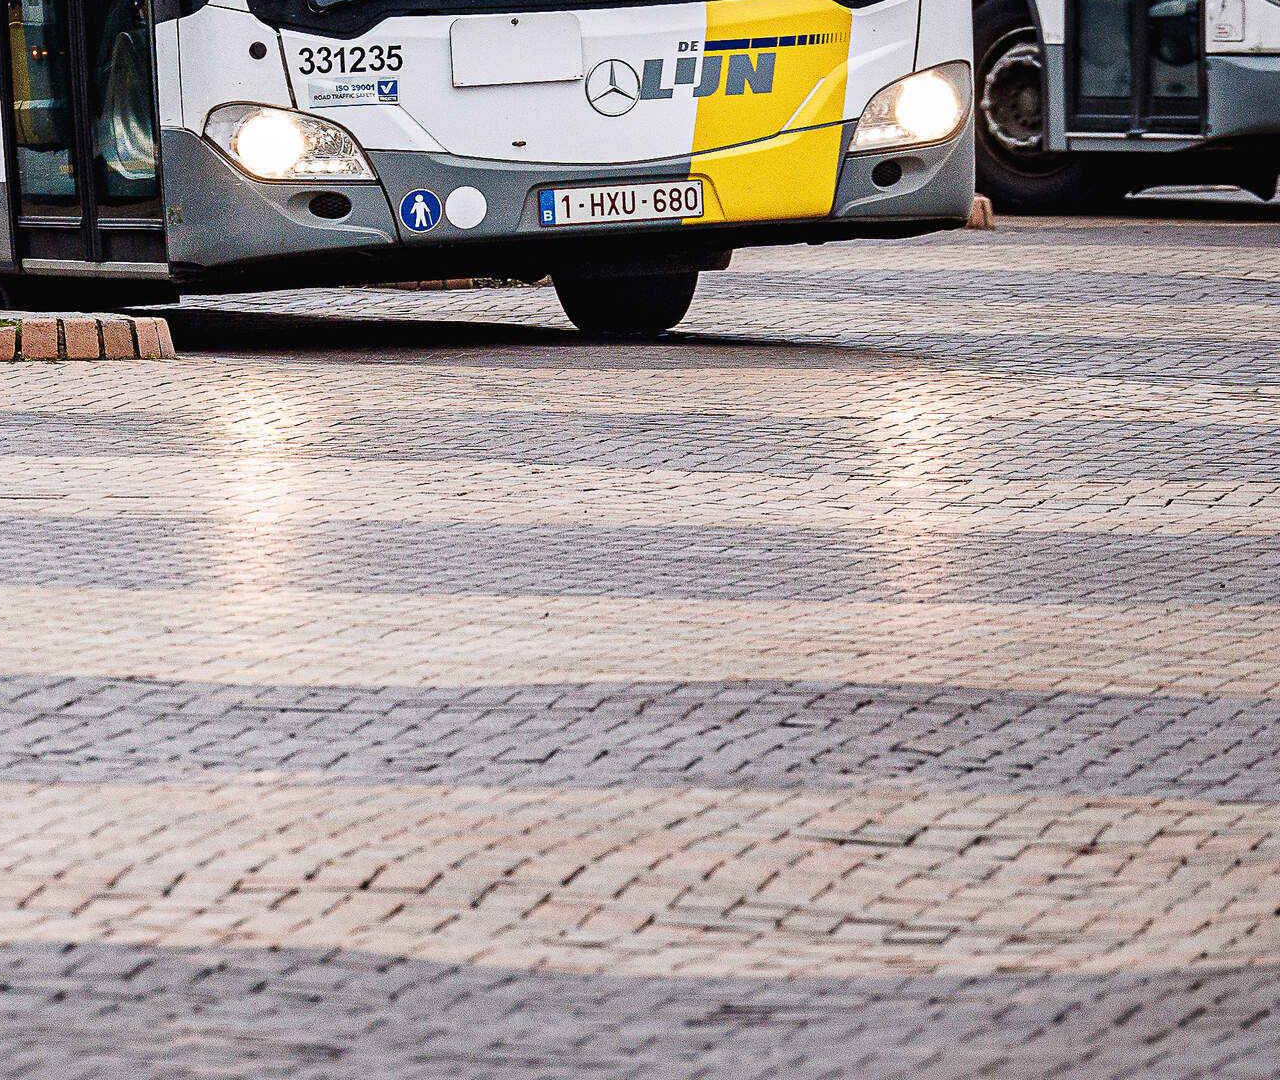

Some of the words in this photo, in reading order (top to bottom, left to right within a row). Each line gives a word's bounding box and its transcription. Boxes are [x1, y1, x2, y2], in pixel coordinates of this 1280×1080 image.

[677, 41, 700, 52] DE
[298, 44, 404, 75] 331235
[640, 52, 776, 100] LIJN
[335, 84, 350, 92] ISO
[351, 83, 375, 91] 39001
[543, 210, 553, 221] B
